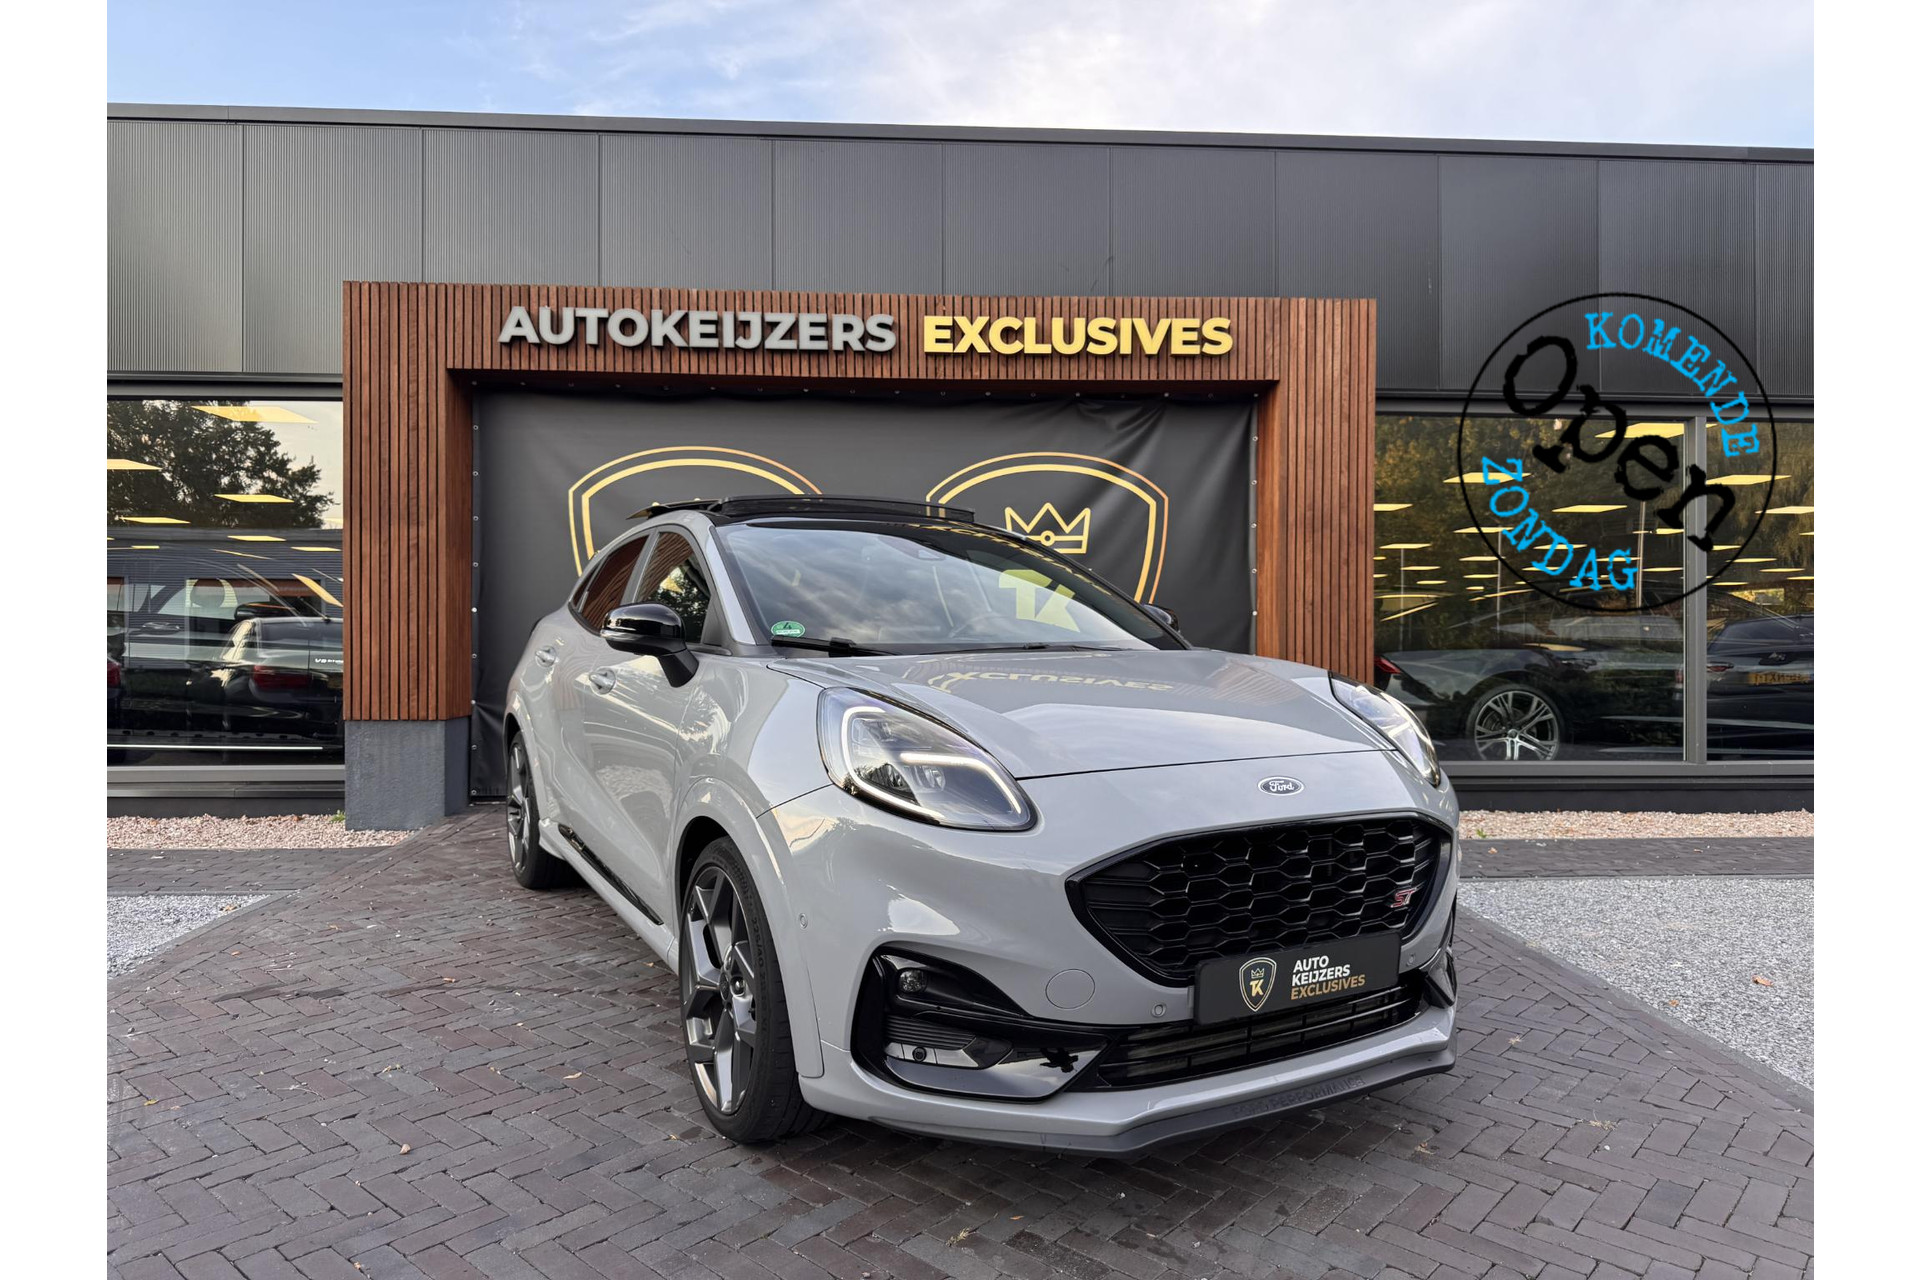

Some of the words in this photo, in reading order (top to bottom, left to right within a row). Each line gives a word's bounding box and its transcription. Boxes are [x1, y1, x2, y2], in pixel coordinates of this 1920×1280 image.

[498, 306, 897, 352] AUTOKEIJZERS
[924, 316, 1233, 355] EXCLUSIVES
[1268, 780, 1295, 792] Ford
[1390, 887, 1417, 908] ST
[1293, 955, 1330, 973] AUTO
[1291, 964, 1351, 986] KEIJZERS
[1250, 978, 1264, 996] TK
[1290, 974, 1366, 1000] EXCLUSIVES
